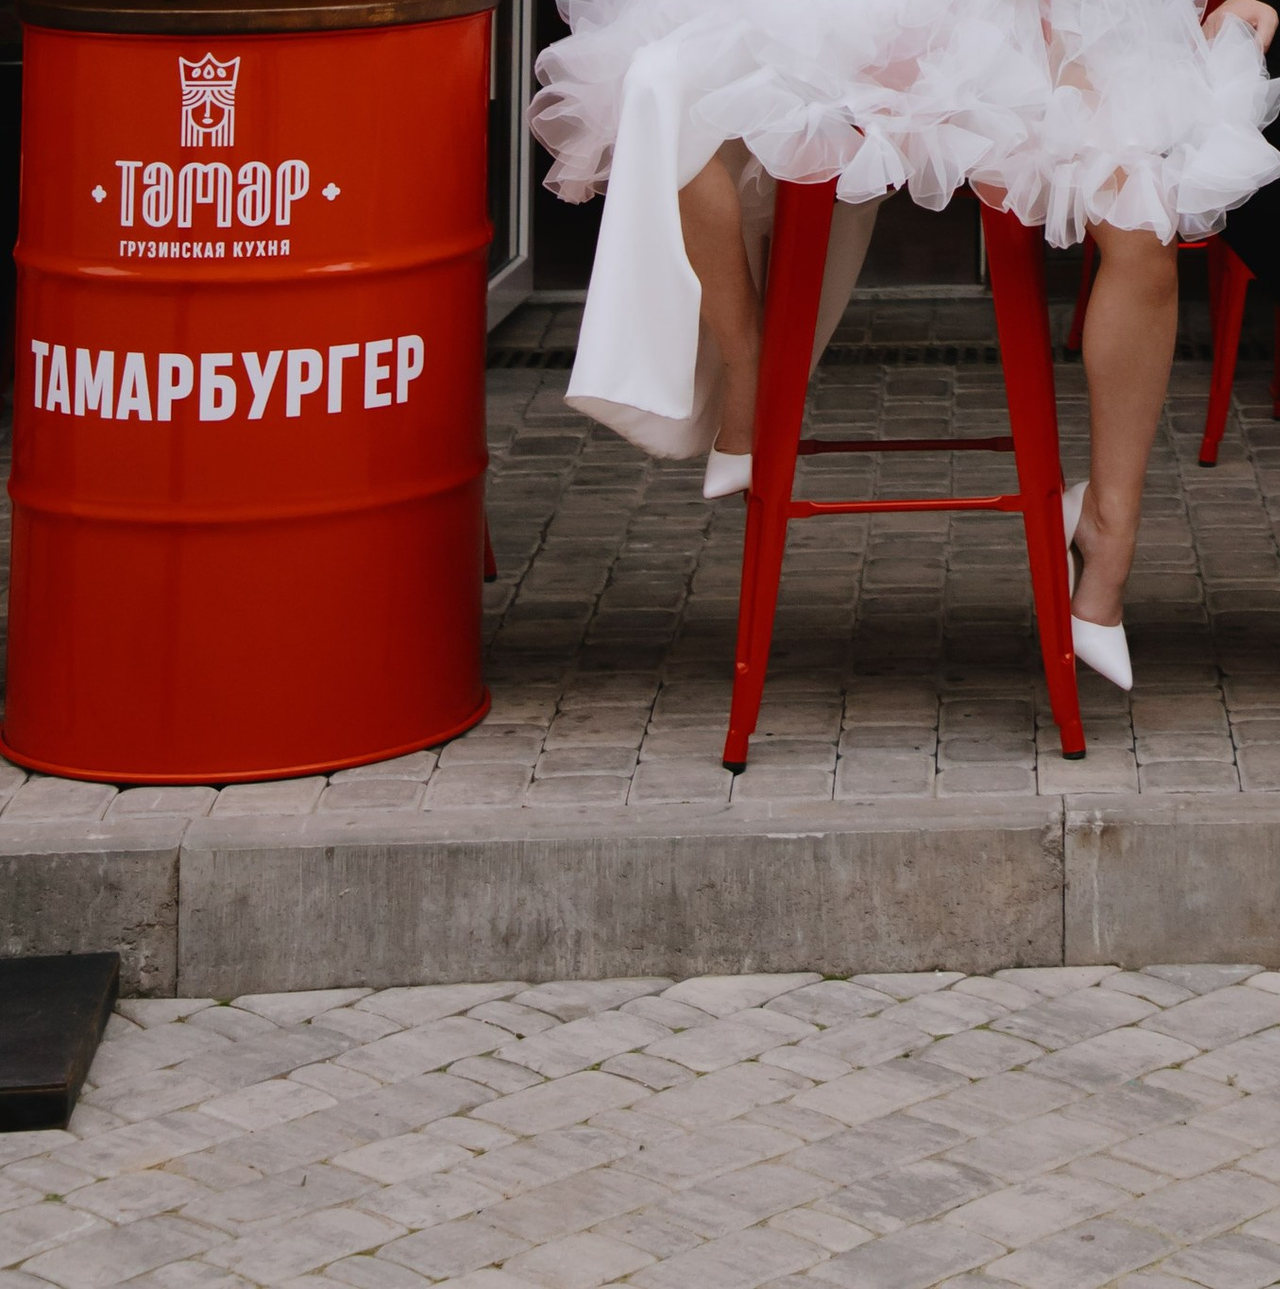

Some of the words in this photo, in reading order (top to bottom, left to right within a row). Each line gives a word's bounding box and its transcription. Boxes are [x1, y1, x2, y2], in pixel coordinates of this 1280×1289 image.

[119, 239, 225, 259] ГРУЗИНСКАЯ
[232, 238, 290, 259] КУХНЯ
[31, 334, 425, 422] ТАМАРБУРГЕР
